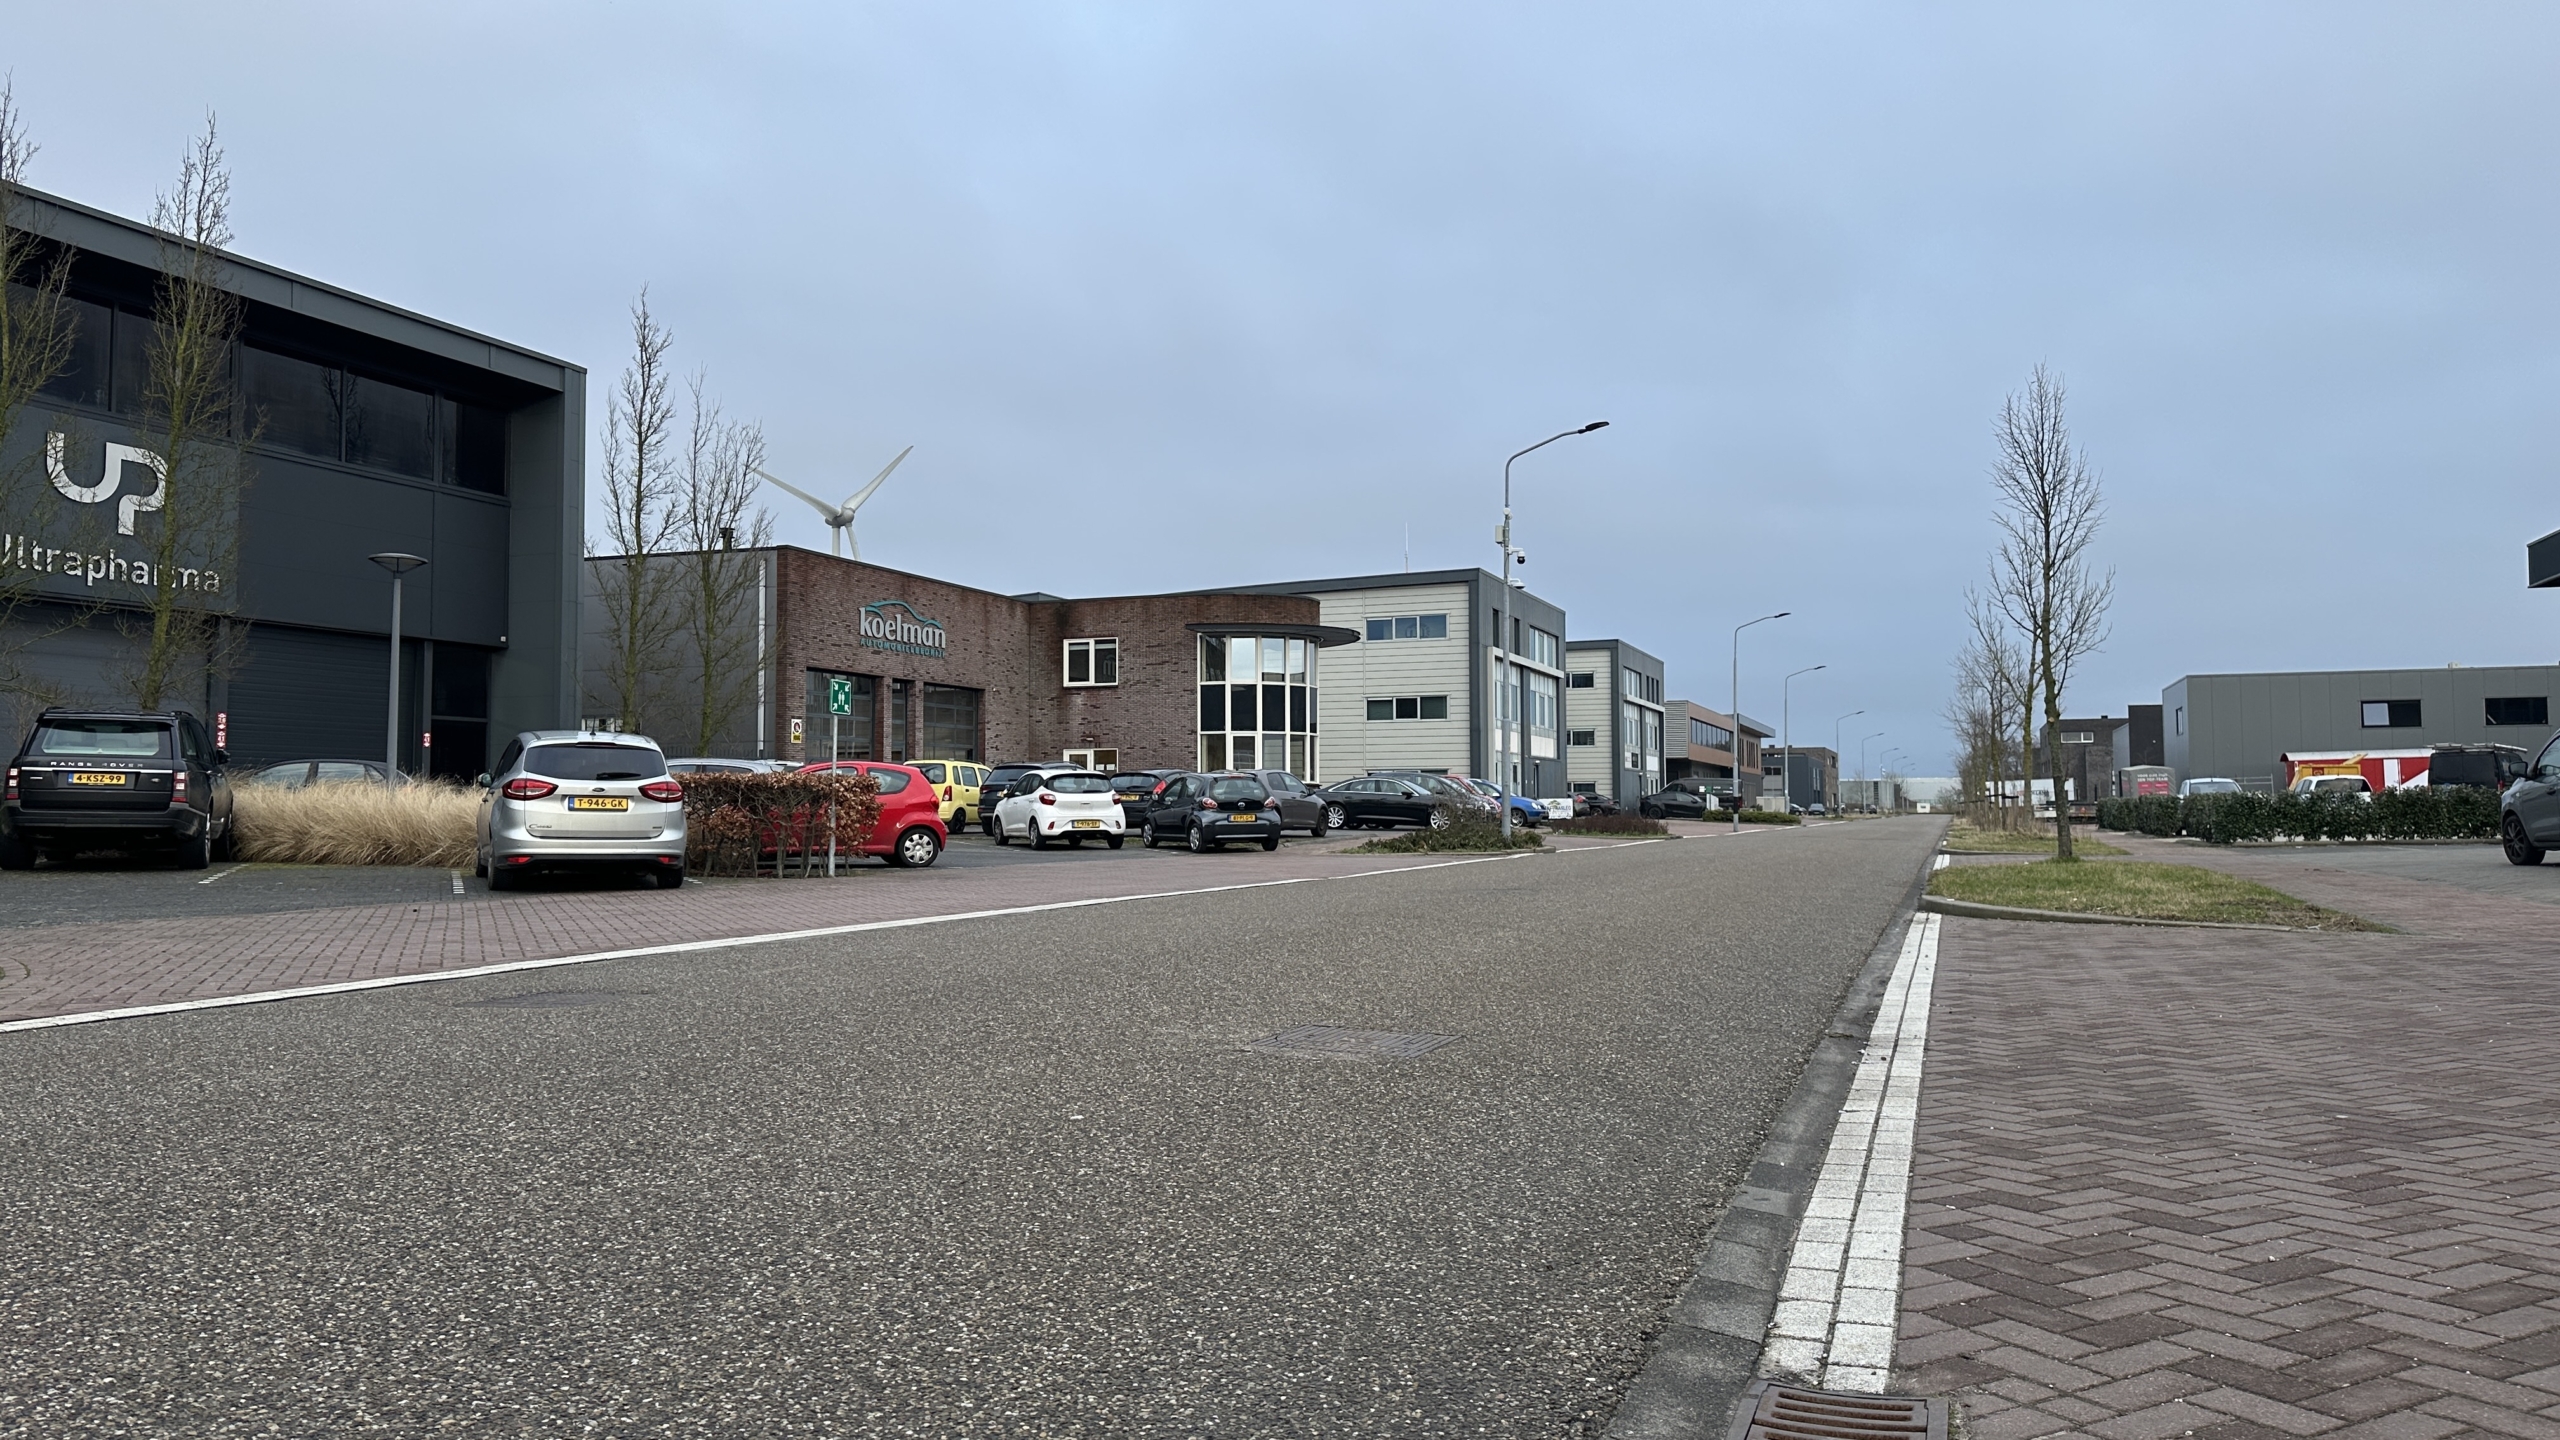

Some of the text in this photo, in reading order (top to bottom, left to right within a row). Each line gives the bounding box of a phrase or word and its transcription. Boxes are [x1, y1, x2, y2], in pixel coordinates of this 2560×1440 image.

[858, 606, 946, 649] koelman
[76, 774, 122, 783] 4-KSZ-99
[577, 798, 624, 808] T-946-GK
